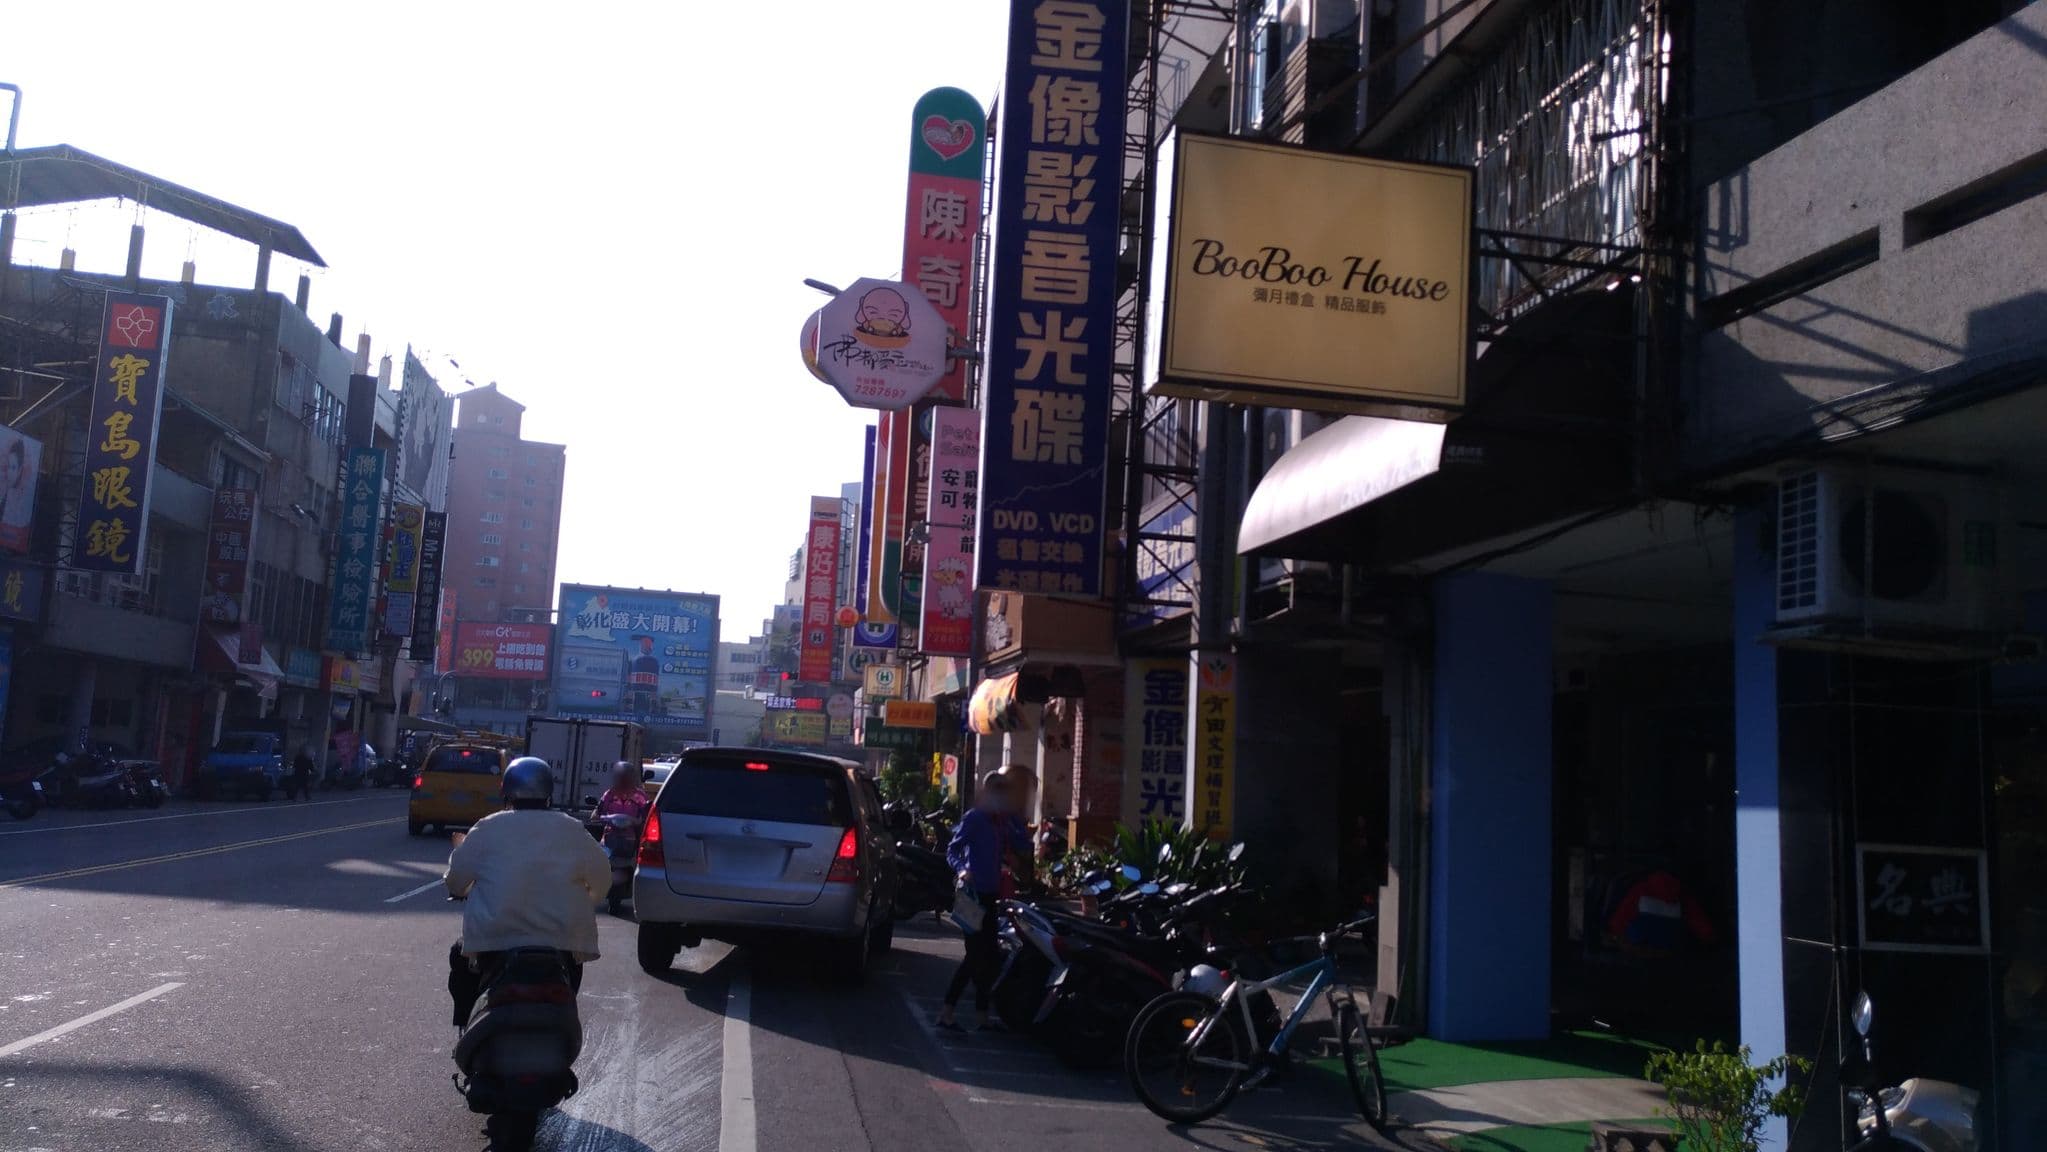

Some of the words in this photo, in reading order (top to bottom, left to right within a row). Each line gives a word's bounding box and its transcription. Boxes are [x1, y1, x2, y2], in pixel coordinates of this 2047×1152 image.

[1011, 0, 1106, 465] 金像影音光碟
[1192, 239, 1332, 287] BooBoo
[1343, 255, 1449, 301] House
[86, 353, 150, 564] 寶島眼鏡
[336, 454, 377, 626] 聯合醫事檢驗所
[1049, 511, 1095, 535] VCD
[1870, 860, 1974, 918] 名典
